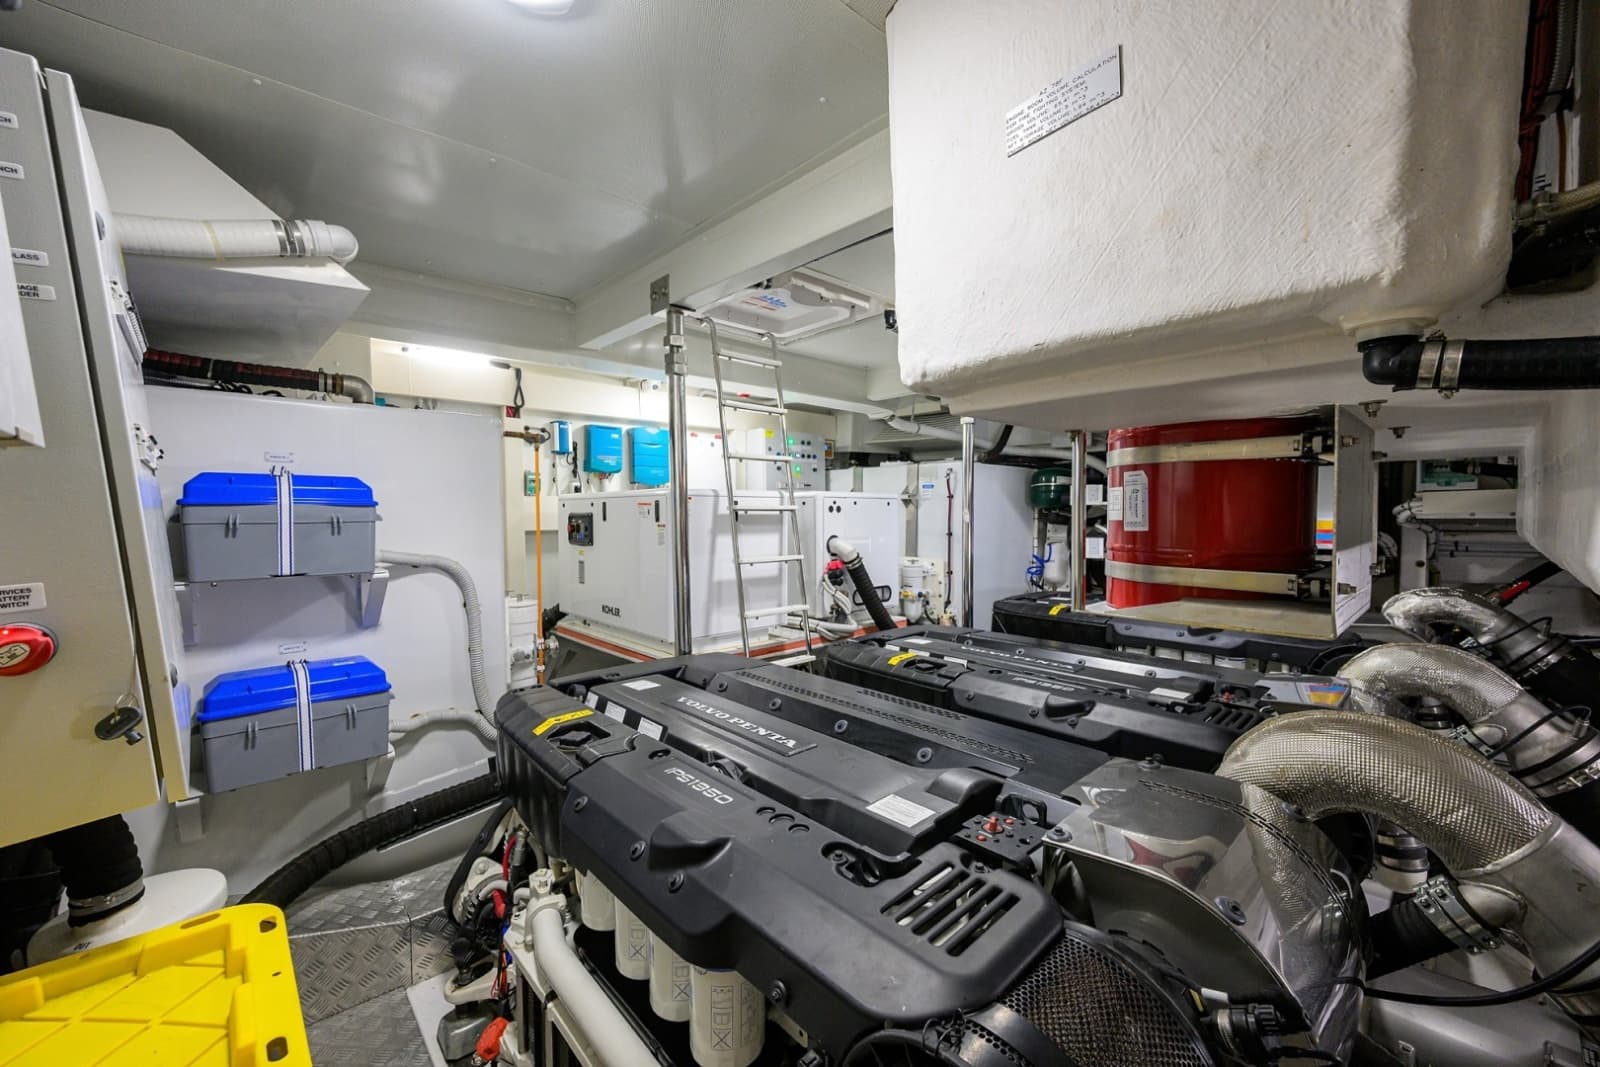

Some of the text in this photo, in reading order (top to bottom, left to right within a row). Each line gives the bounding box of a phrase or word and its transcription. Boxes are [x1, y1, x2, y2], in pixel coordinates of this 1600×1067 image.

[1027, 97, 1043, 110] ROOM
[1046, 81, 1071, 99] VOLUME
[1072, 55, 1117, 83] CALCULATION
[12, 252, 40, 261] LASS
[676, 696, 798, 749] VOLVO PENTA
